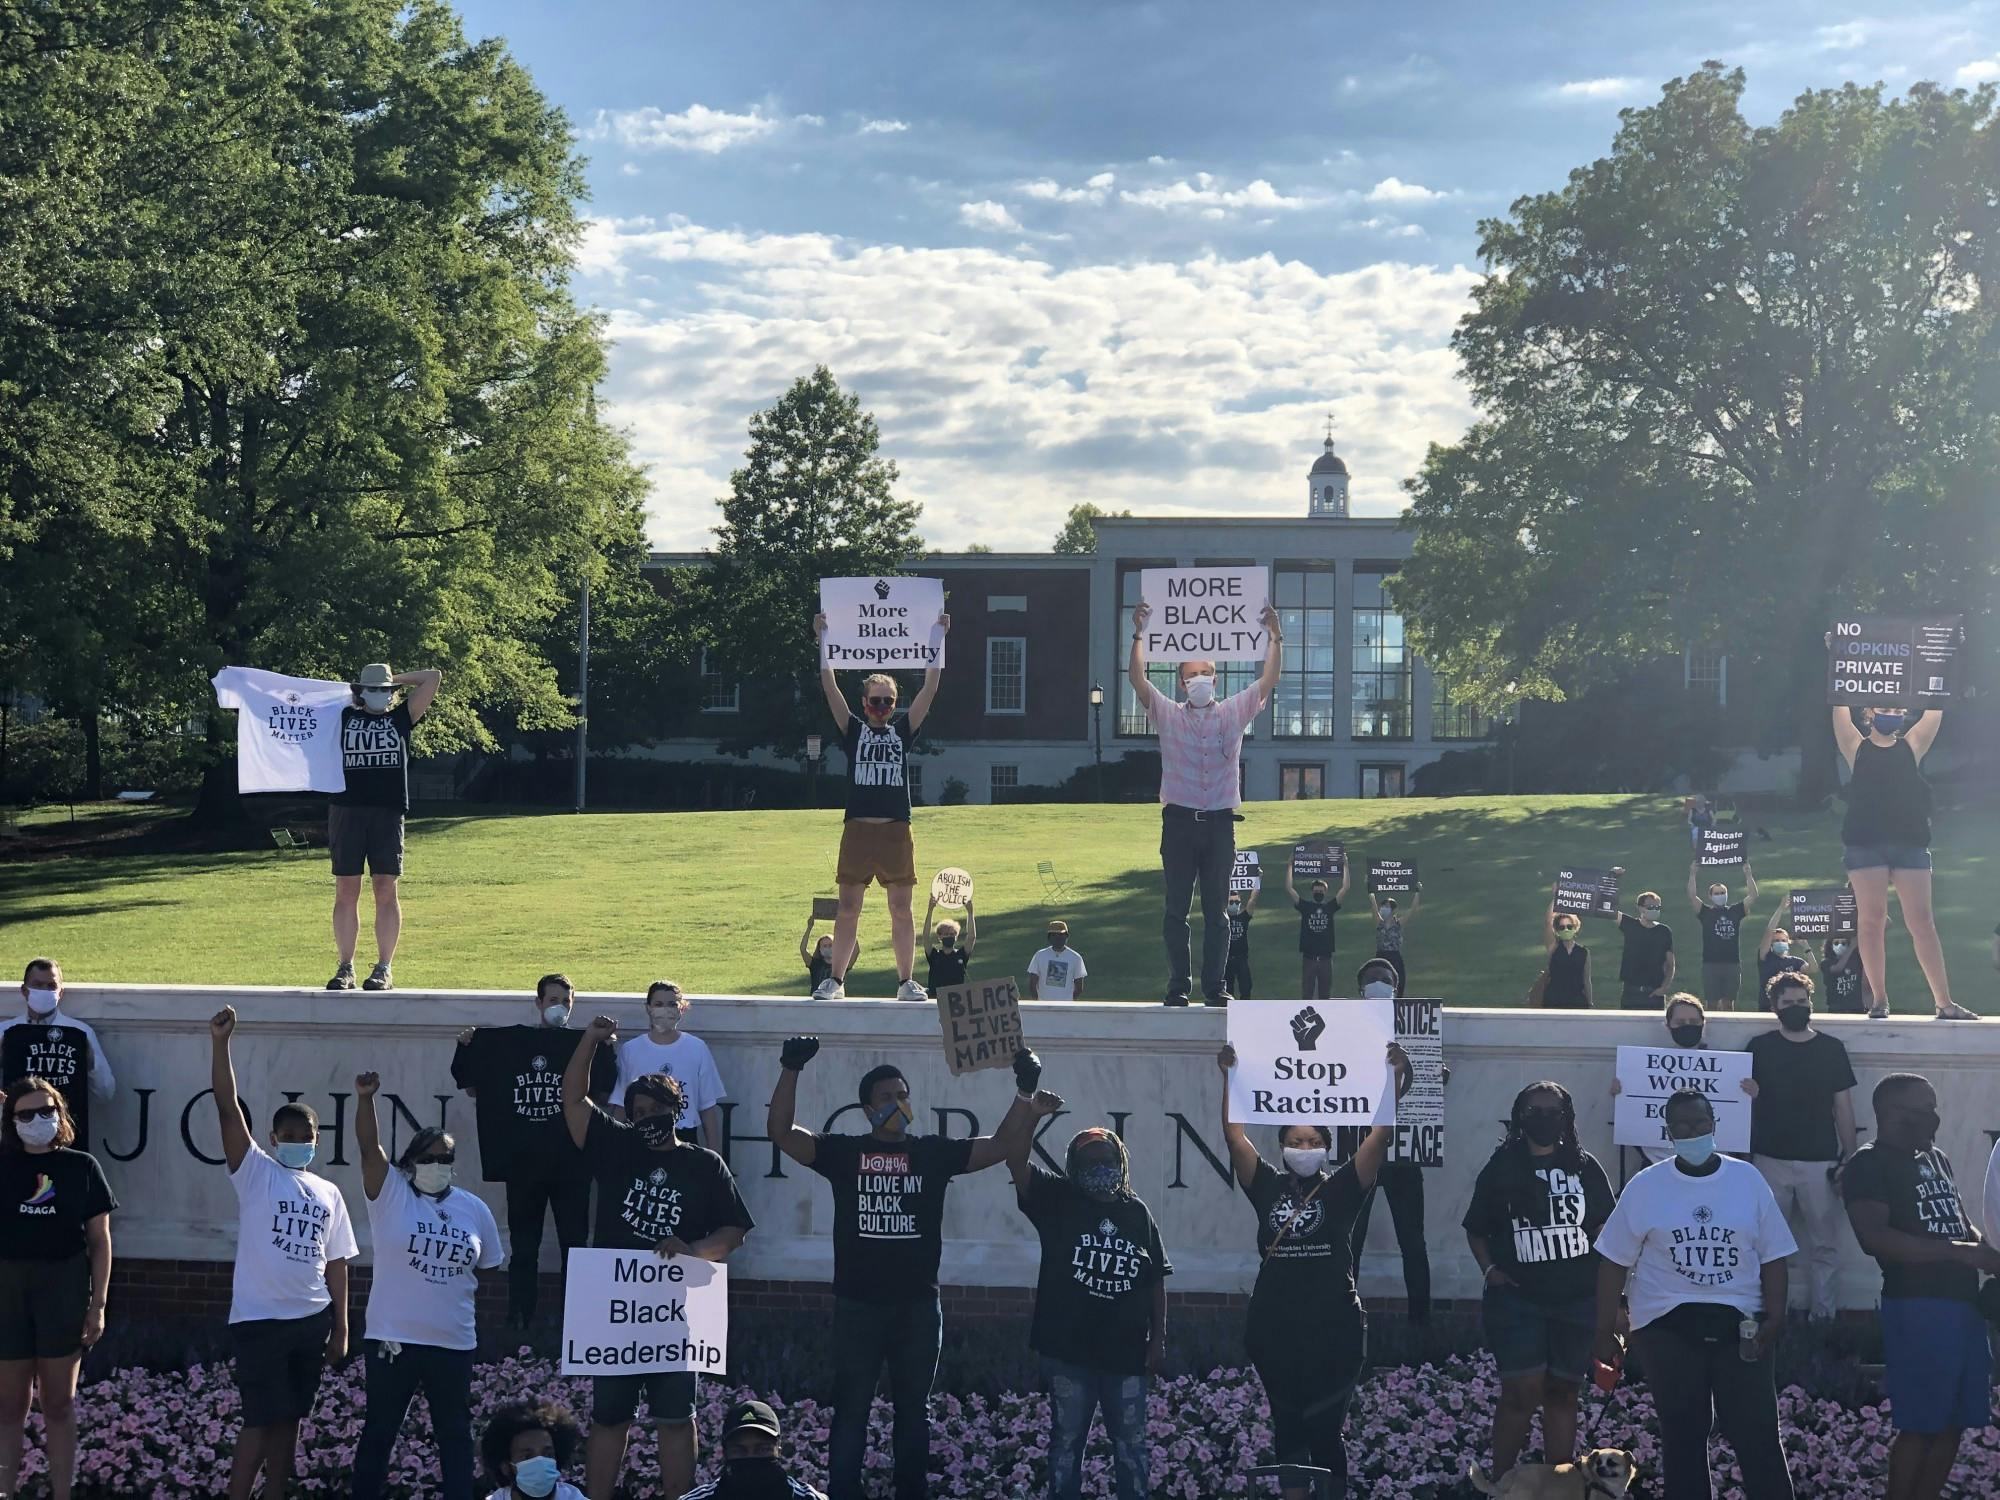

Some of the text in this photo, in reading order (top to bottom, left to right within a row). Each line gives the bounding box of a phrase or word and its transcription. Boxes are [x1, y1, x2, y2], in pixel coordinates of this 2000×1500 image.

[1168, 577, 1242, 598] MORE
[859, 603, 908, 618] More
[1164, 604, 1246, 624] BLACK
[858, 623, 909, 638] Black
[1837, 623, 1861, 636] NO
[1149, 632, 1262, 652] FACULTY
[828, 643, 940, 663] Prosperity
[1835, 660, 1903, 676] PRIVATE
[1834, 680, 1900, 694] POLICE!
[272, 705, 315, 718] BLACK
[269, 717, 317, 730] LIVES
[348, 718, 393, 730] BLACK
[271, 730, 314, 740] MATTER
[346, 731, 398, 750] LIVES
[346, 752, 398, 767] MATTER
[860, 744, 902, 762] LIVES
[1704, 830, 1742, 840] Educate
[1704, 843, 1738, 852] Agitate
[1701, 856, 1742, 865] Liberate
[938, 873, 971, 887] ABOLISH
[1372, 868, 1412, 876] INJUSTICE
[946, 884, 960, 894] THE
[1230, 879, 1254, 888] TTER
[938, 892, 968, 904] POLICE
[1558, 890, 1592, 900] PRIVATE
[1557, 899, 1590, 910] POLICE!
[948, 984, 1018, 1017] BLACK
[1394, 1000, 1442, 1035] STICE
[952, 1012, 1021, 1042] LIVES
[30, 1042, 76, 1058] BLACK
[26, 1057, 76, 1074] LIVES
[1274, 1056, 1347, 1086] Stop
[1645, 1054, 1722, 1074] EQUAL
[516, 1072, 562, 1086] BLACK
[1648, 1075, 1720, 1094] WORK
[514, 1087, 562, 1104] LIVES
[1252, 1089, 1370, 1114] Racism
[516, 1104, 562, 1116] MATTER
[103, 1088, 454, 1166] JOHN
[858, 1174, 922, 1194] I LOVE MY
[20, 1204, 56, 1214] DSAGA
[623, 1188, 682, 1226] LIVES
[858, 1194, 902, 1212] BLACK
[278, 1201, 330, 1224] BLACK
[272, 1215, 325, 1242] LIVE
[858, 1214, 916, 1232] CULTURE
[417, 1222, 470, 1244] BLACK
[1672, 1226, 1735, 1244] BLACK
[408, 1234, 474, 1266] LIVES
[1081, 1234, 1136, 1255] BLACK
[1514, 1226, 1590, 1263] MATTER
[1072, 1246, 1140, 1278] LIVES
[1669, 1246, 1738, 1267] LIVES
[409, 1256, 464, 1278] MATTER
[614, 1258, 684, 1283] More
[1676, 1266, 1734, 1285] MATTER
[1074, 1268, 1132, 1292] MATTER
[610, 1299, 686, 1324] Black
[568, 1338, 720, 1368] Leadership
